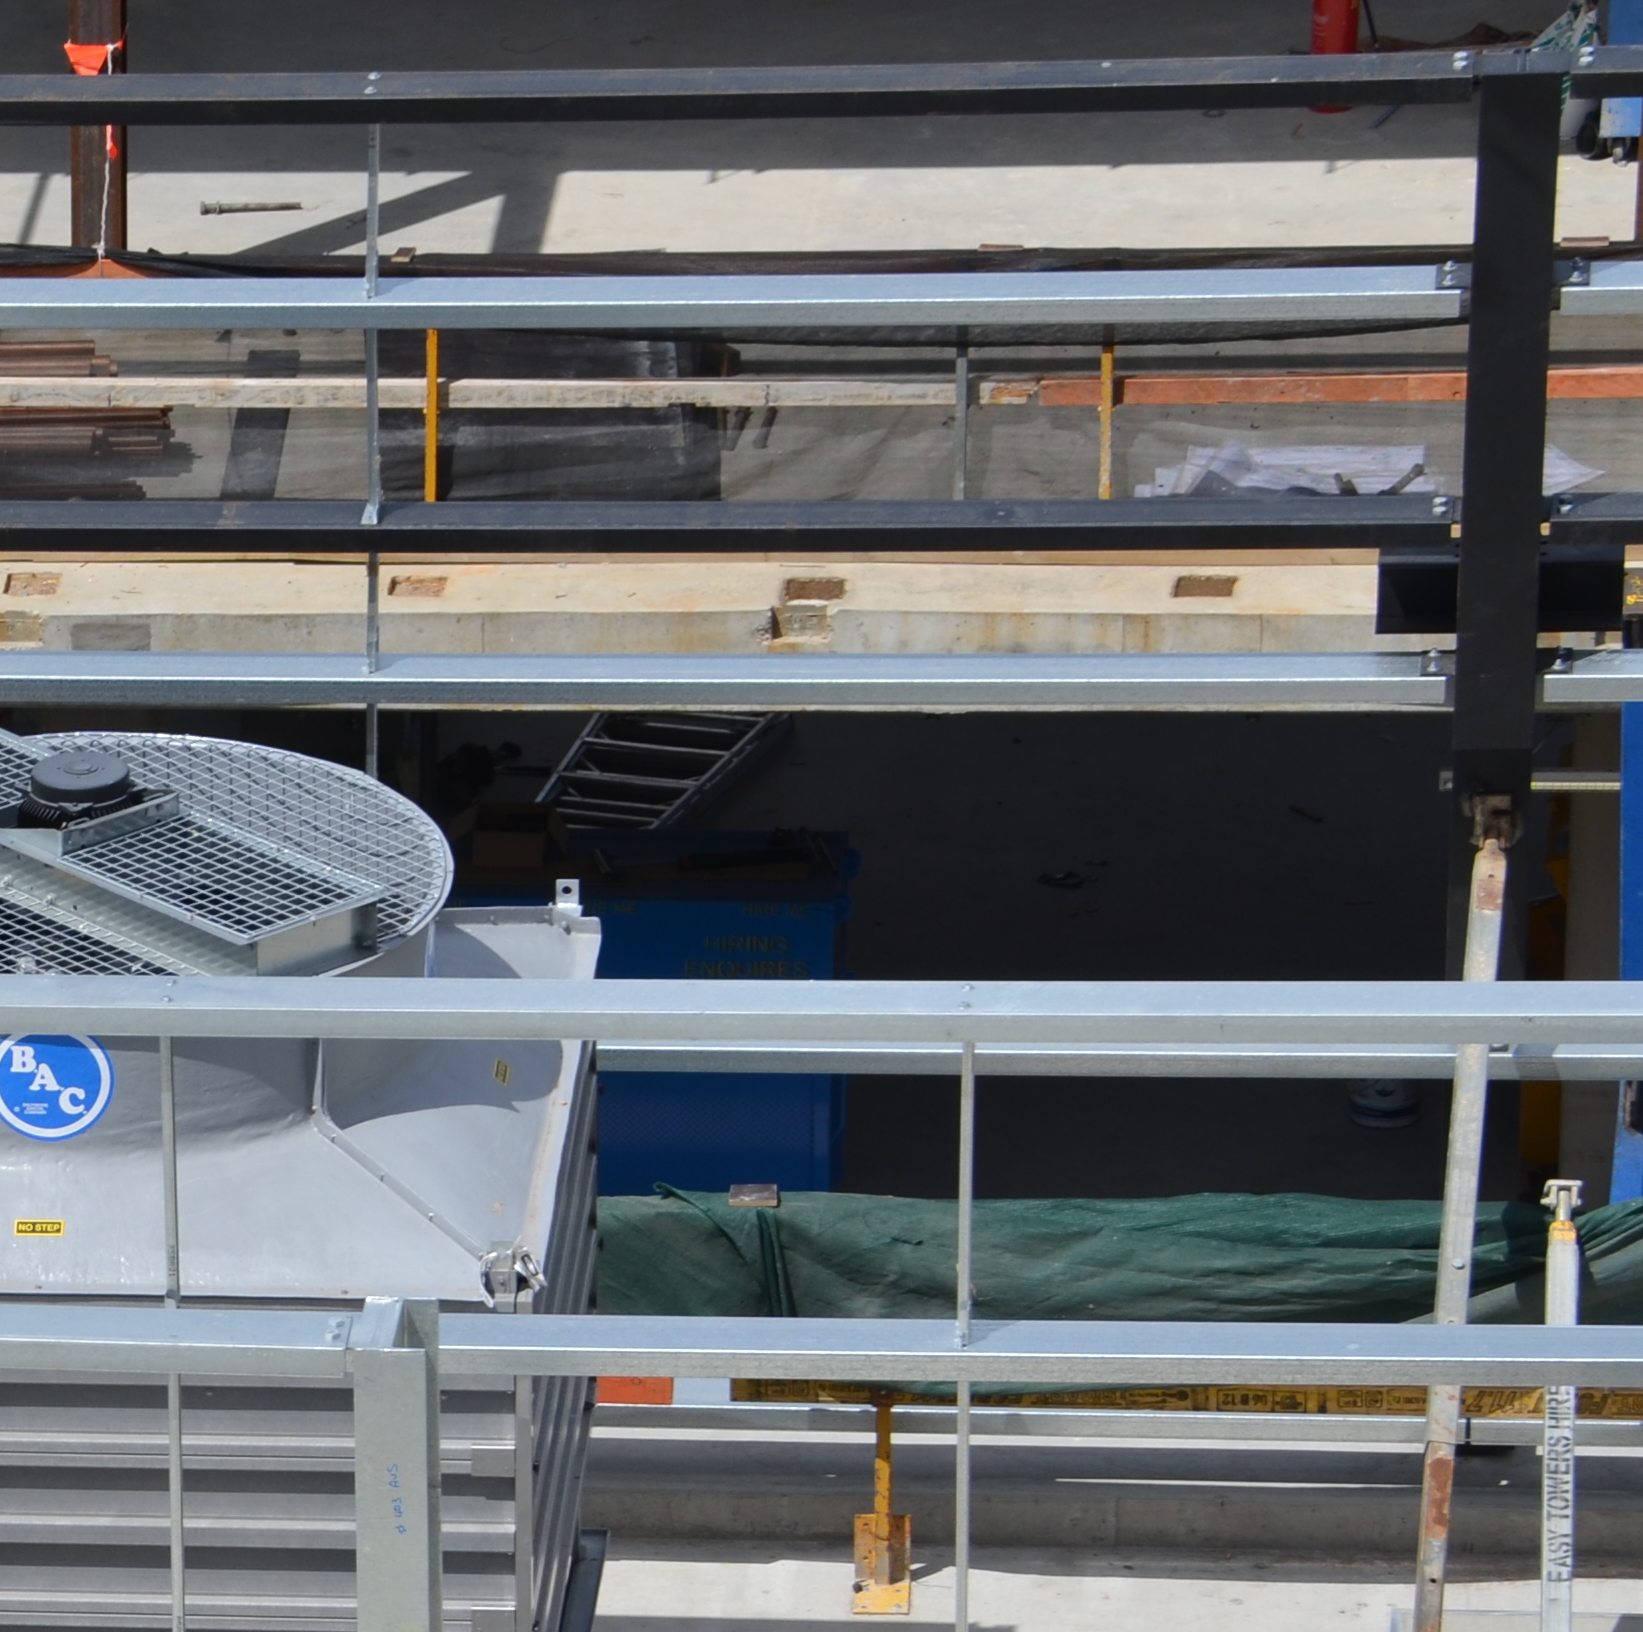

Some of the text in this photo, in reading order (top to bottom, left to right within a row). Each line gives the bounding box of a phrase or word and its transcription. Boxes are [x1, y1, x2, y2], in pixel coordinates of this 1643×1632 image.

[704, 935, 790, 953] HIRING
[682, 959, 809, 979] ENQUIRES
[18, 1223, 61, 1231] NO STEP
[1546, 1435, 1572, 1520] TOWERS
[1546, 1531, 1572, 1583] EASY
